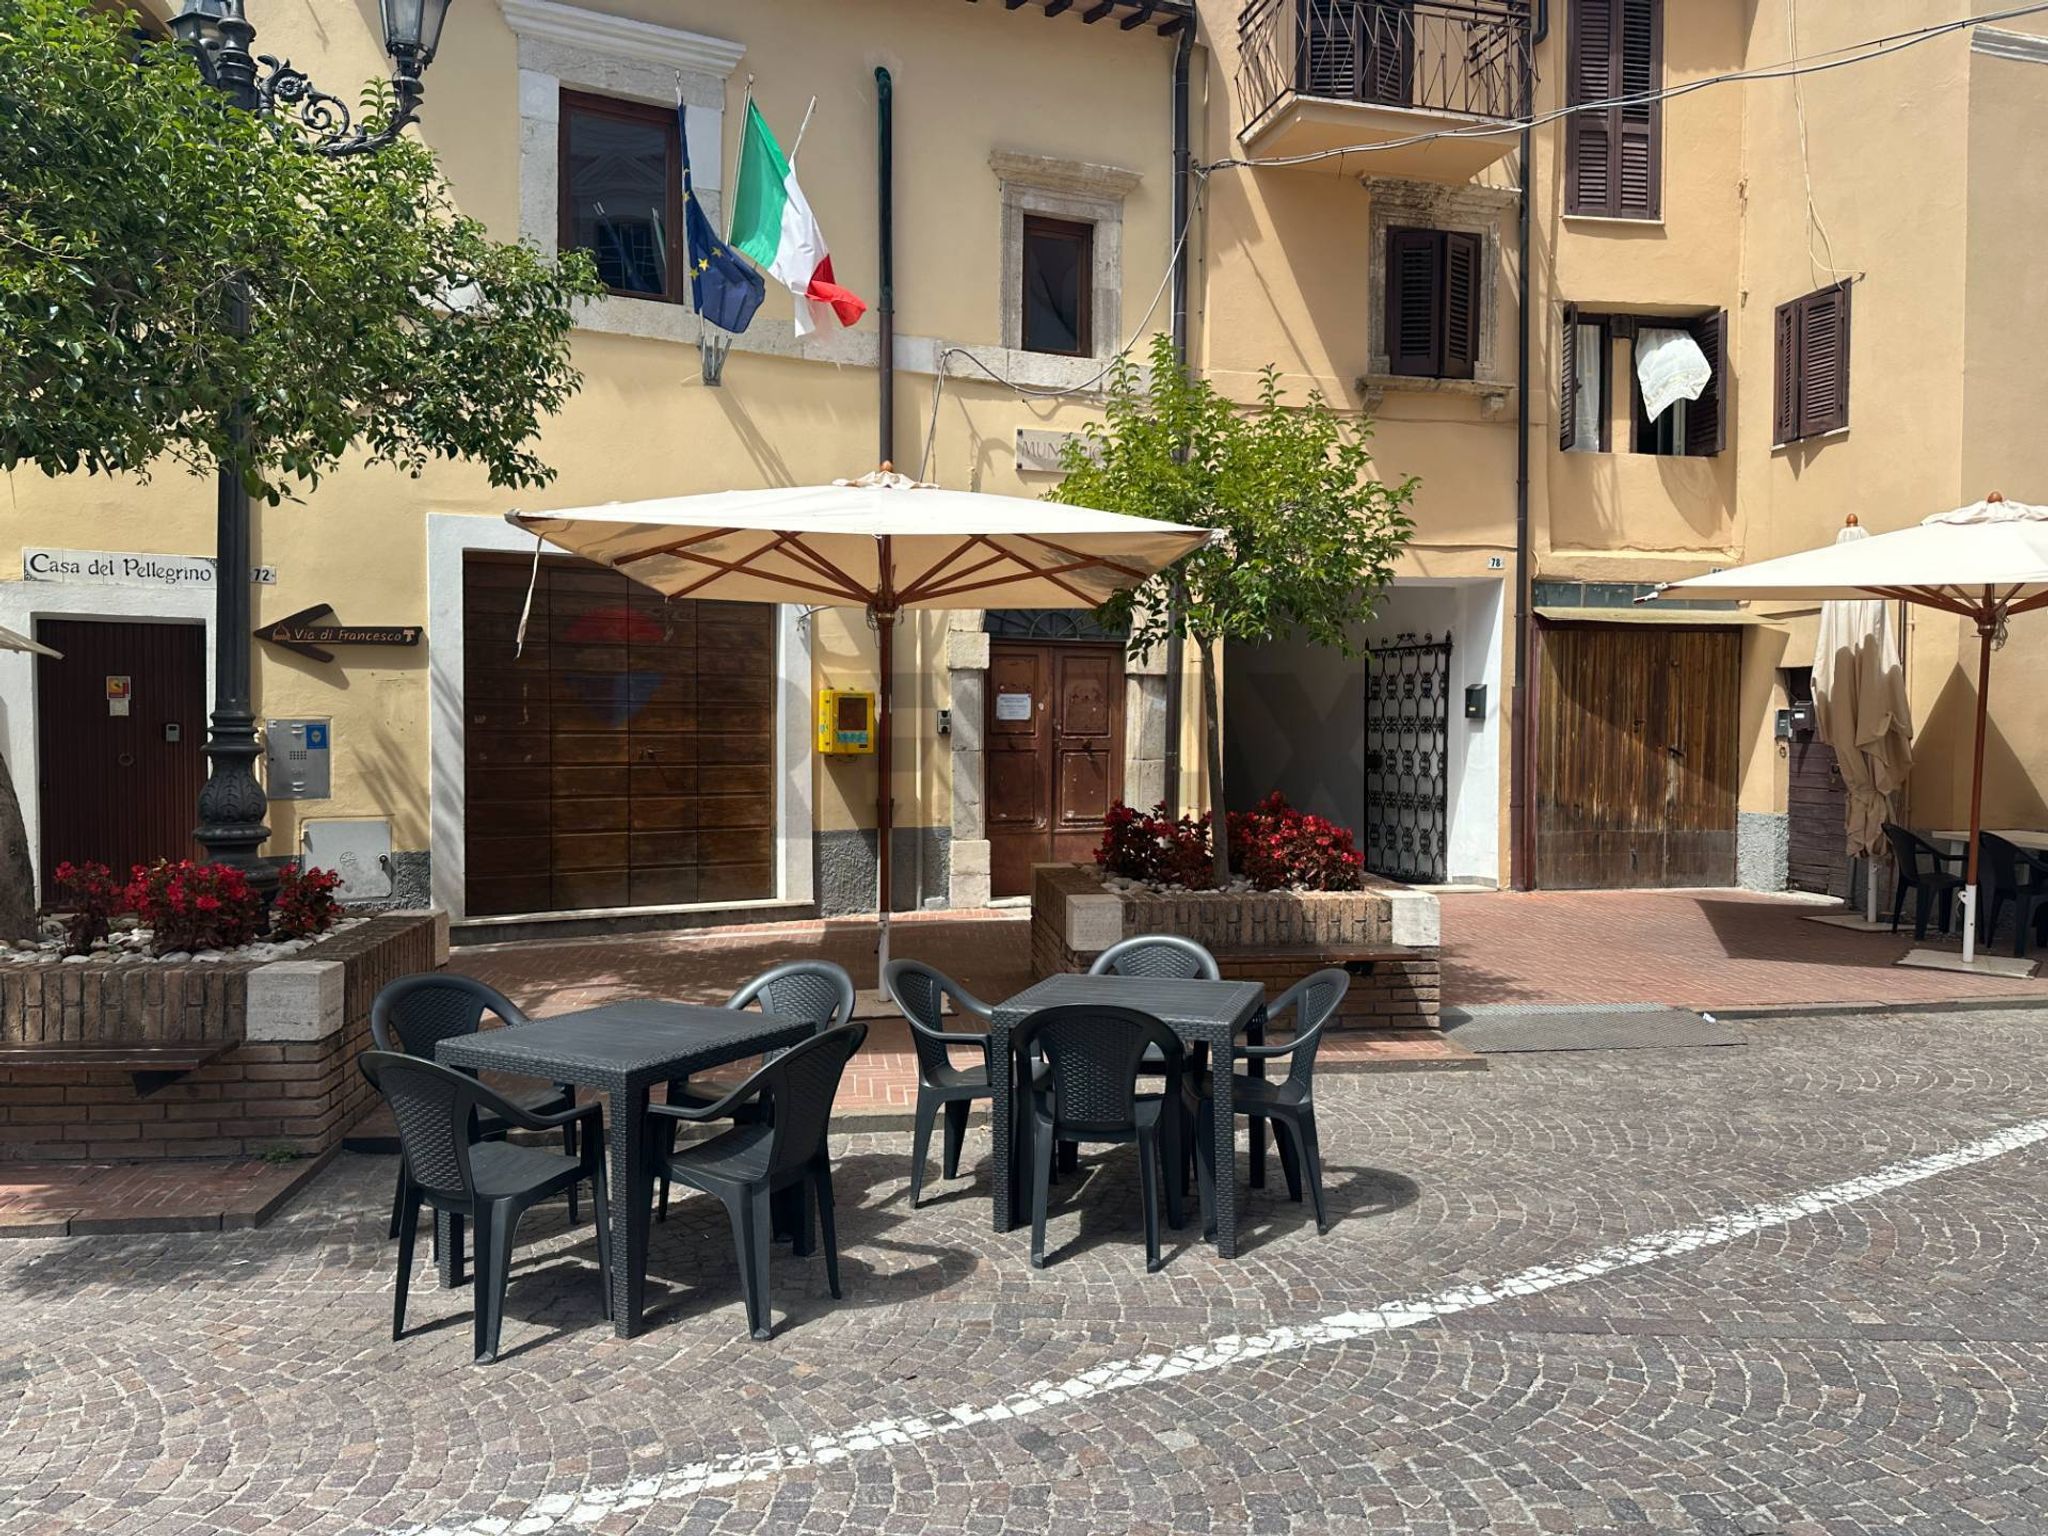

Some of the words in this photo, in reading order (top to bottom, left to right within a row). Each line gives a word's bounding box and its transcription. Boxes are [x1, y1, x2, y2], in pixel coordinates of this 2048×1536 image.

[30, 553, 80, 573] Casa
[88, 559, 114, 576] del
[123, 558, 212, 584] Pellegrino
[1491, 557, 1501, 568] 78
[253, 568, 270, 582] 72
[294, 628, 315, 640] Via
[320, 628, 333, 640] di
[339, 629, 401, 641] Francesco
